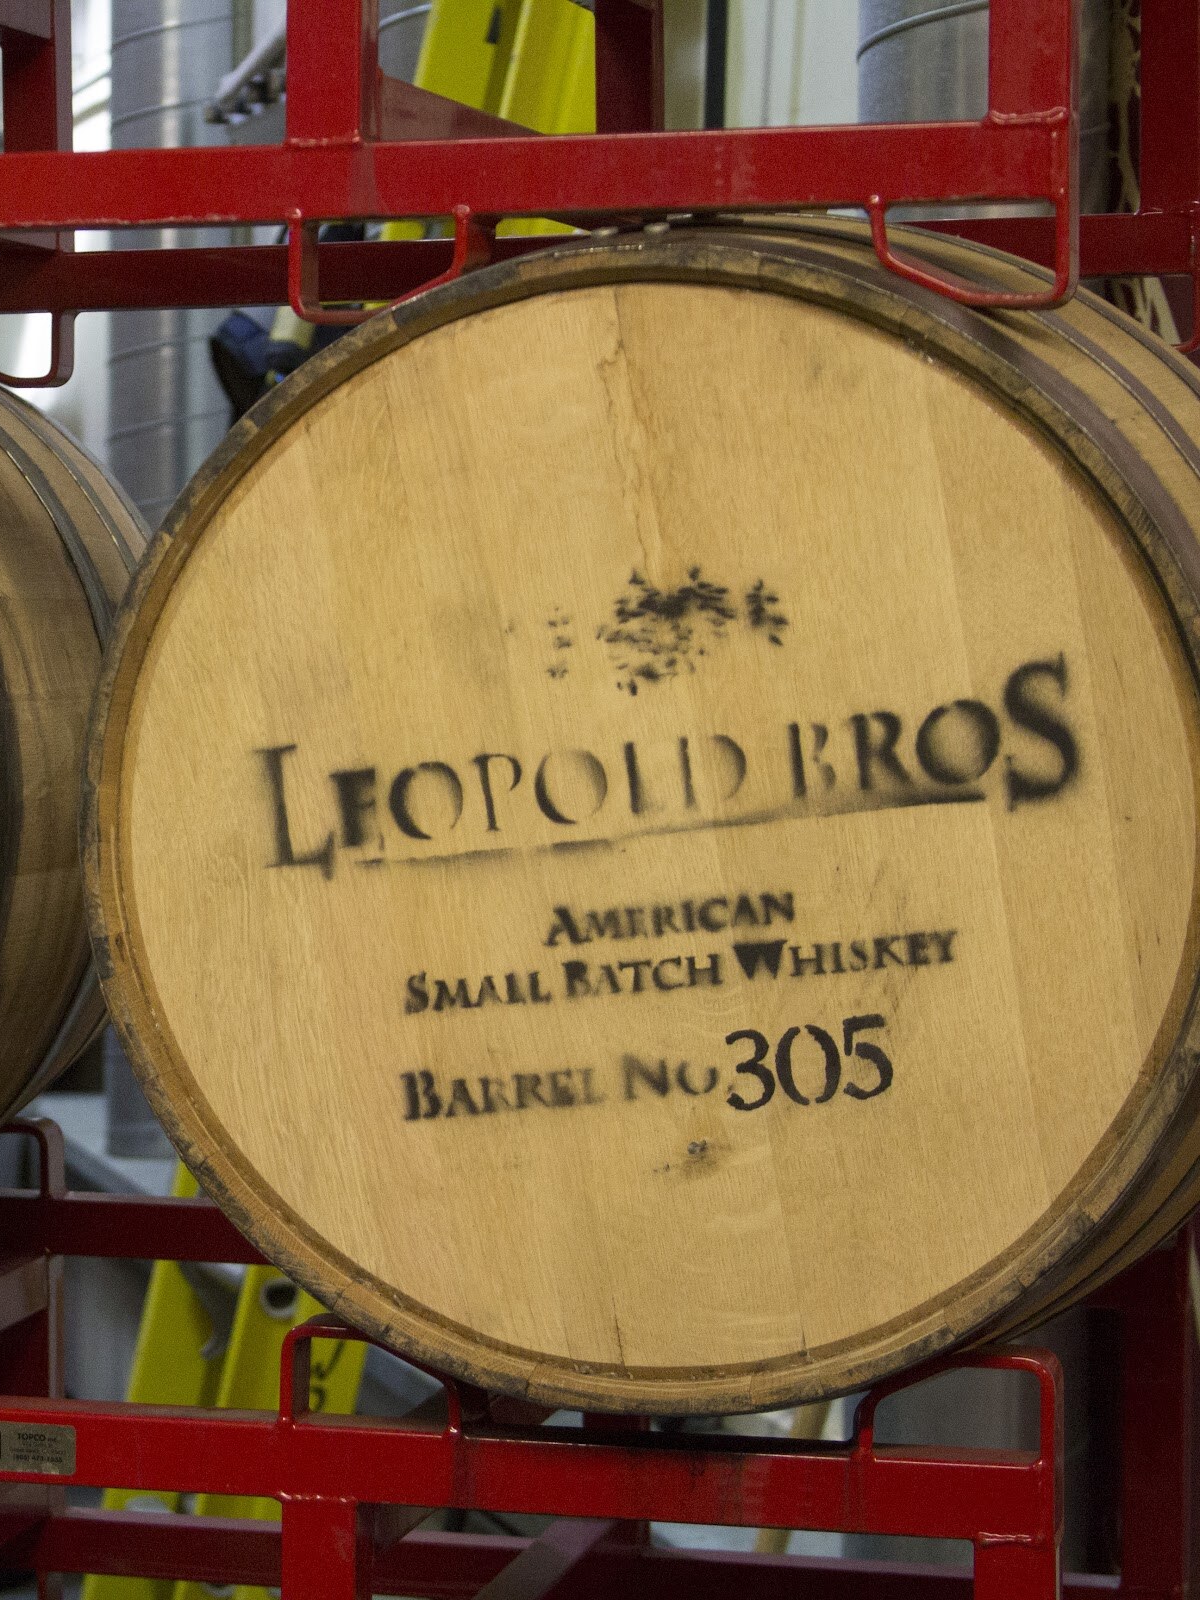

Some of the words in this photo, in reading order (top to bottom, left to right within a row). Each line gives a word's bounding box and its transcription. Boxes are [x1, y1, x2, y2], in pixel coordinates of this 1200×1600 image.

[255, 734, 747, 881] LEOPOLD
[788, 650, 1079, 813] BROS
[543, 892, 796, 947] AMERICAN
[404, 970, 552, 1015] SMALL
[562, 955, 724, 998] BATCH
[733, 931, 957, 980] WHISKEY
[400, 1068, 606, 1121] BARREL
[725, 1014, 894, 1111] 305
[17, 1432, 47, 1442] TOPCO
